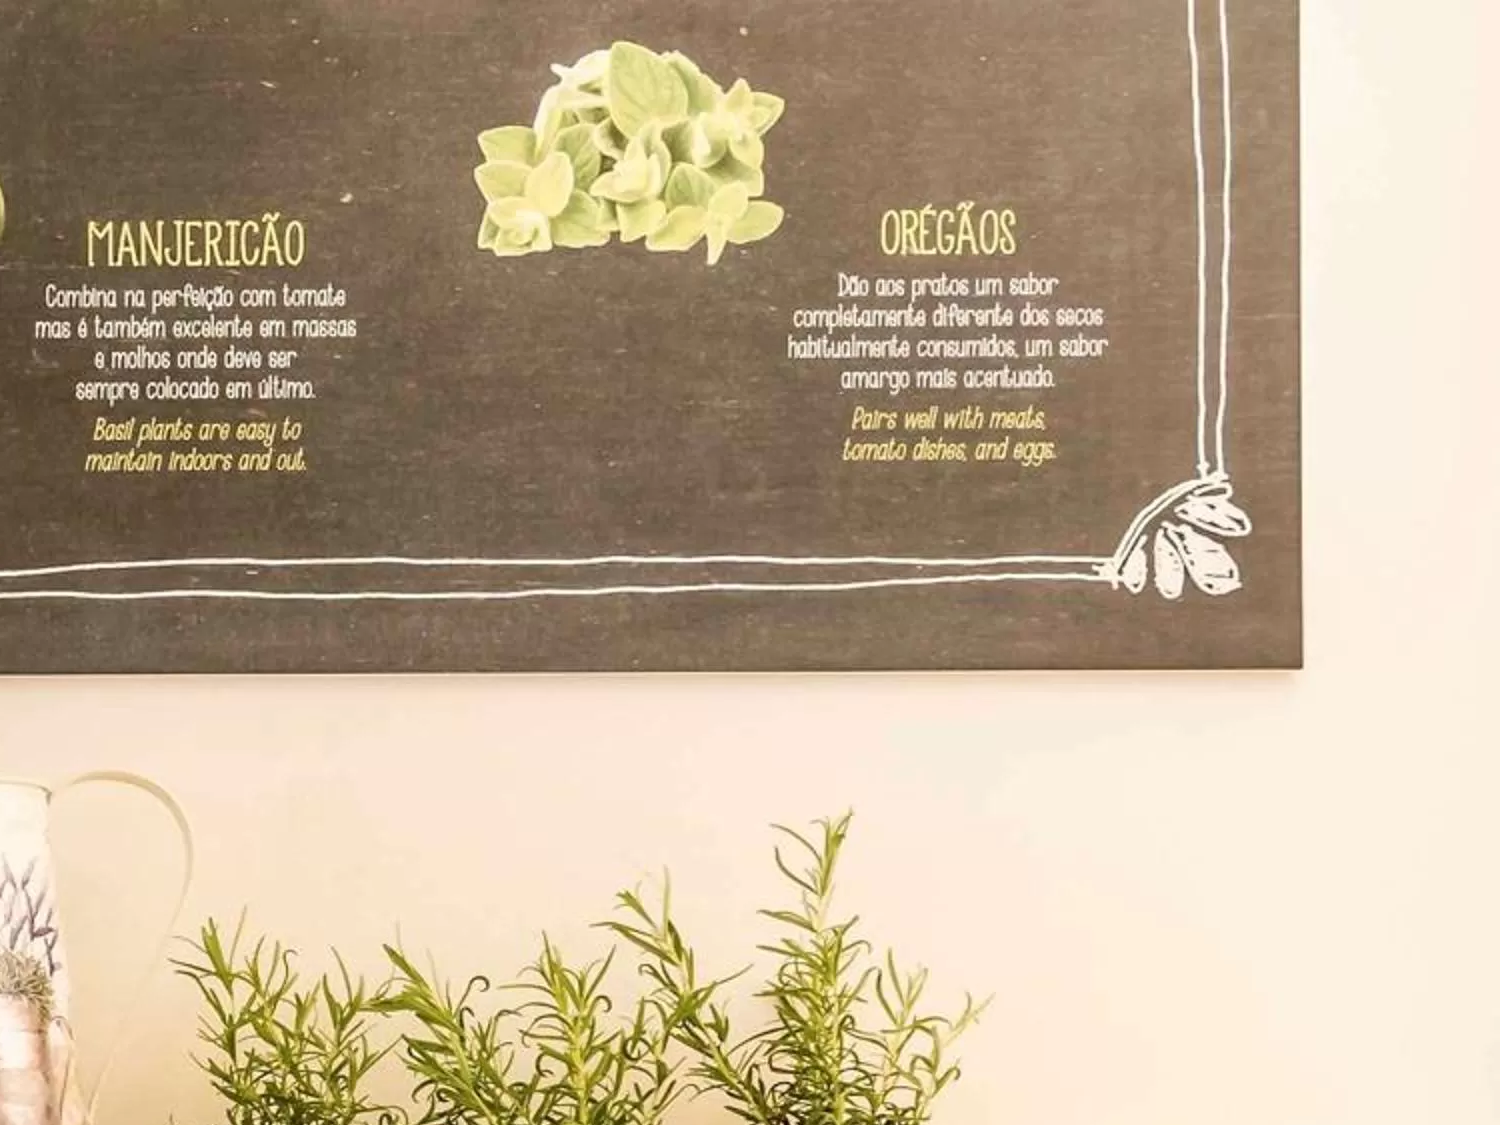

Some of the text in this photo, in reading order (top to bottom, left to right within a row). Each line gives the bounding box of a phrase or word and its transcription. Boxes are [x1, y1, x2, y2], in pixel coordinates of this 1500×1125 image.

[87, 212, 306, 267] MANJERICÃO
[881, 201, 1017, 255] ORÉGÃOS
[45, 283, 346, 313] Combina na perfeição com tomate
[837, 272, 1060, 302] Dão aos pratos um sabor
[35, 314, 357, 338] mas é também excelente em massas
[793, 304, 1104, 334] completamente diferente dos secos
[94, 345, 298, 369] e molhos onde deve ser
[787, 335, 910, 359] habitualmente
[1025, 338, 1052, 356] um
[1059, 334, 1109, 356] sabor
[75, 375, 316, 407] sempre colocado em último.
[841, 370, 909, 394] amargo
[916, 367, 957, 388] mais
[852, 406, 897, 430] Pairs
[904, 406, 938, 429] well
[943, 405, 984, 429] with
[93, 417, 301, 449] Basil plants are easy to
[85, 449, 163, 473] maintain
[168, 448, 233, 472] indoors
[238, 448, 271, 472] and
[843, 439, 907, 462] tomato
[975, 437, 1008, 459] and
